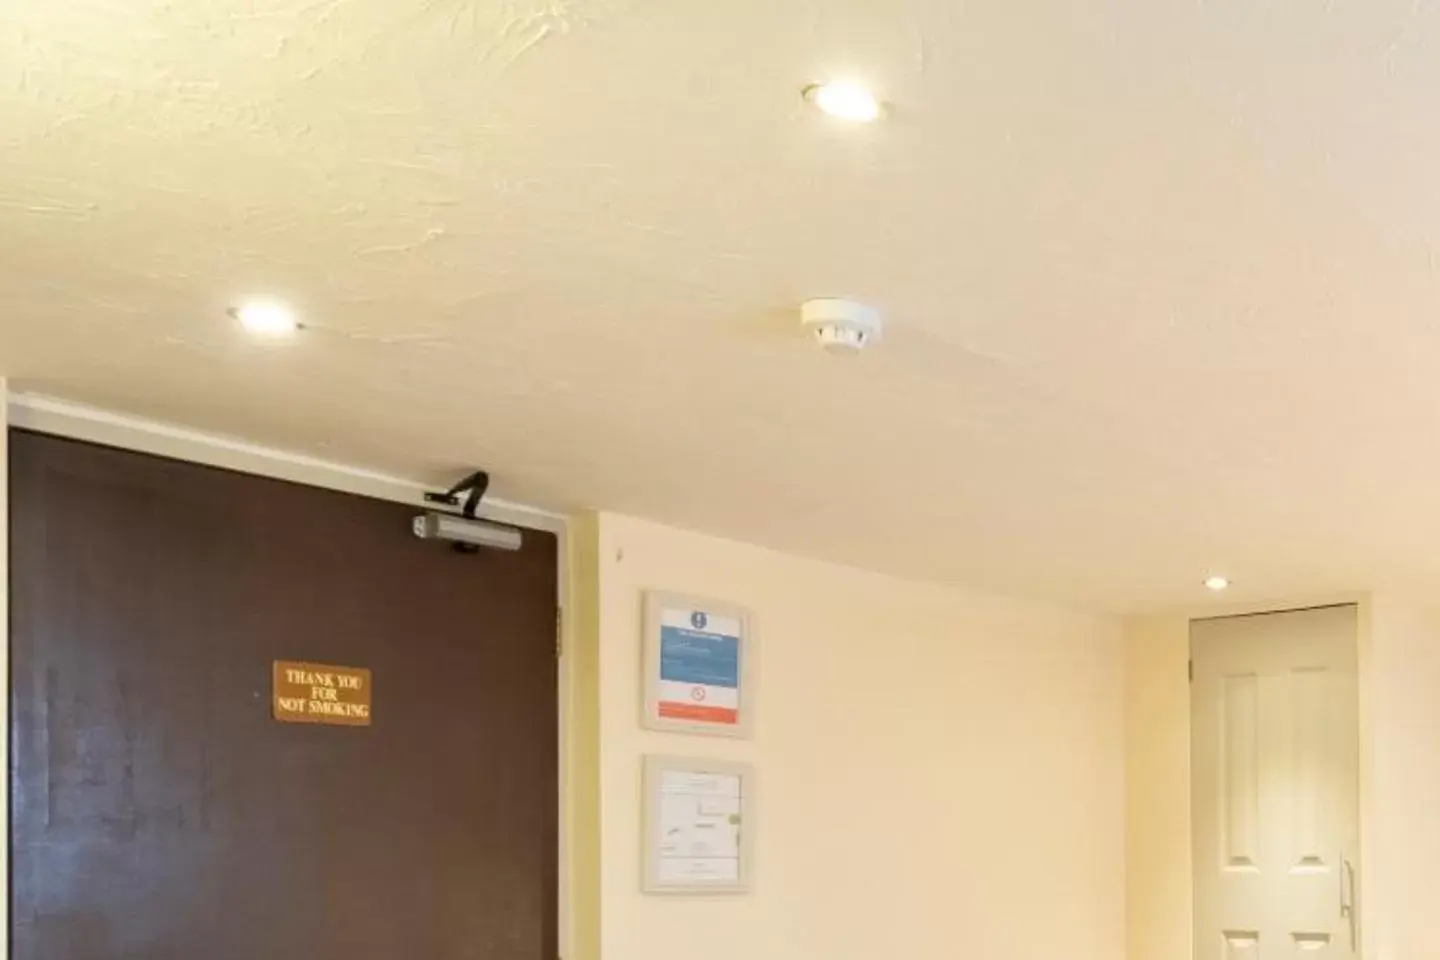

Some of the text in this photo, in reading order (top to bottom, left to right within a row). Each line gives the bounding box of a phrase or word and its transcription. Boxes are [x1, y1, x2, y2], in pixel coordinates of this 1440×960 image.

[286, 669, 362, 690] THANK YOU
[312, 686, 338, 701] FOR
[278, 697, 369, 717] NOT SMOKING
